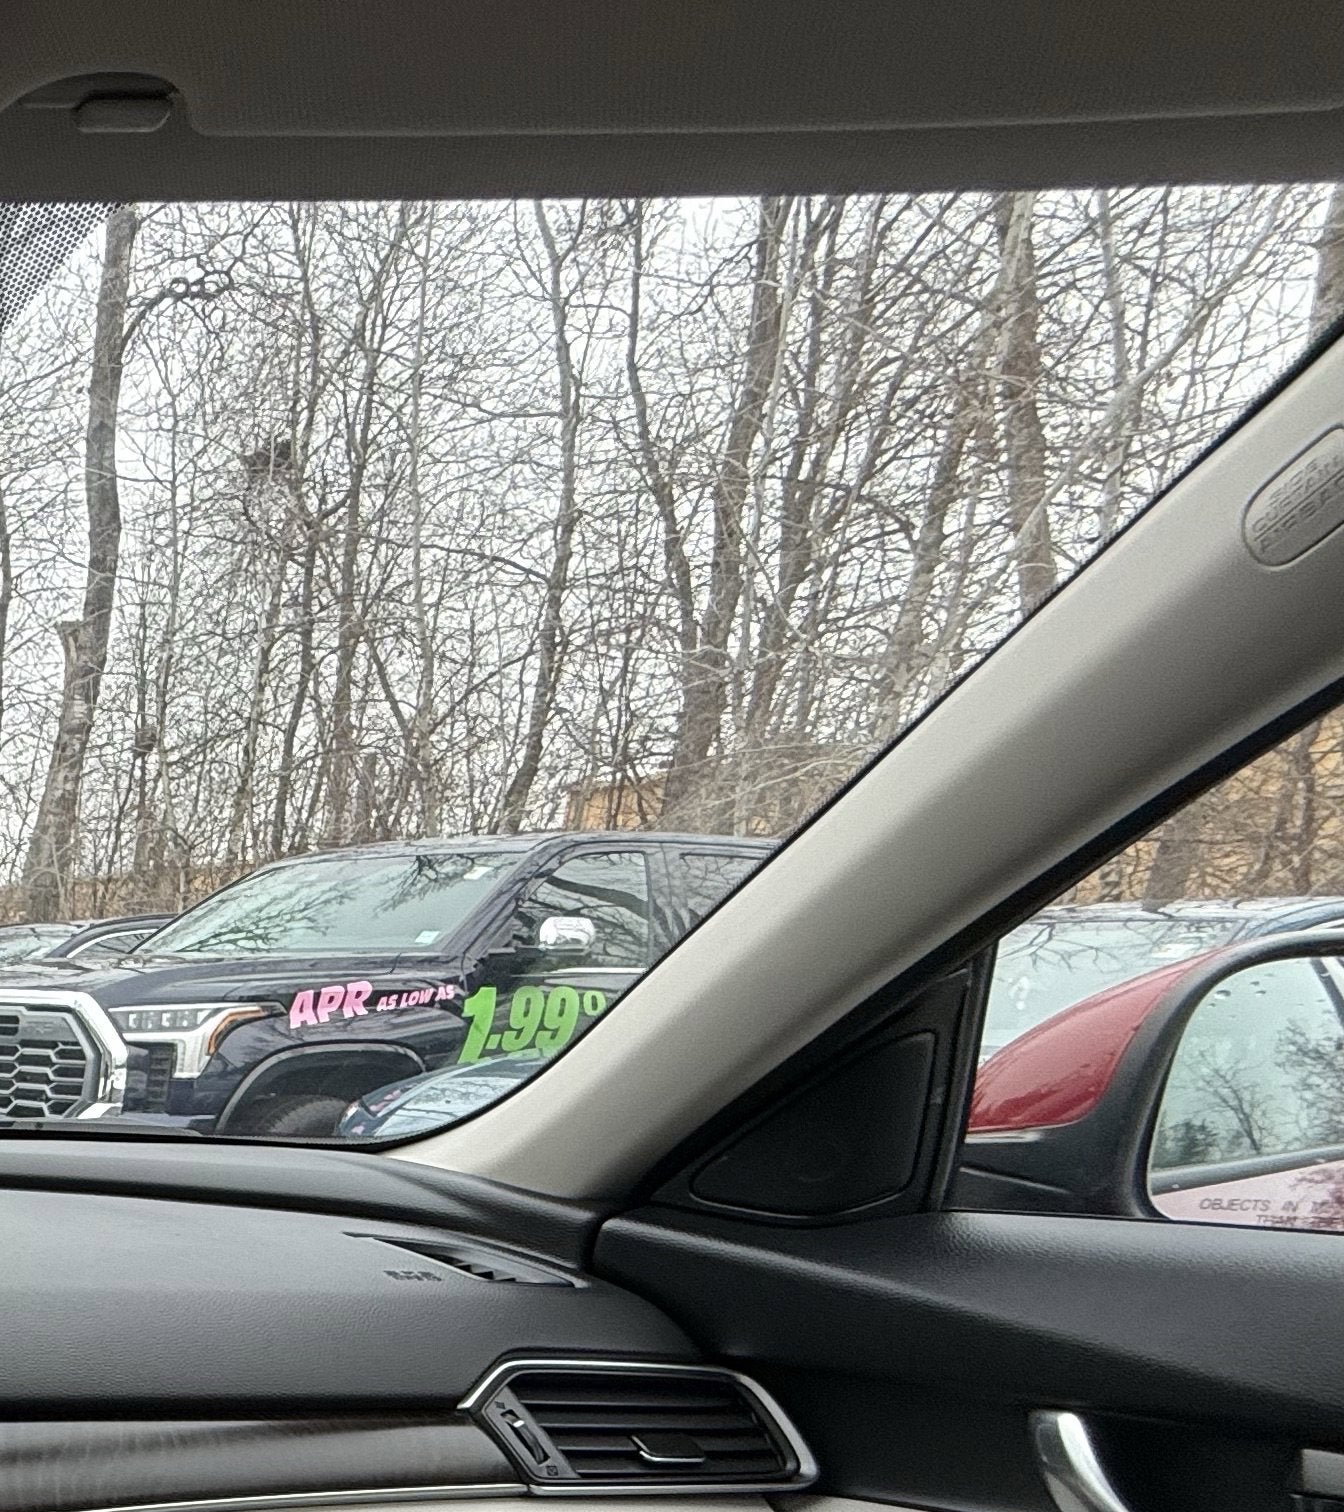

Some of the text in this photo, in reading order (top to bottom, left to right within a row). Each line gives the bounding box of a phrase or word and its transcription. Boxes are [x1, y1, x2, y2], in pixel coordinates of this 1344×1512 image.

[289, 980, 455, 1030] APR AS LOW AS
[1198, 1198, 1271, 1212] OBJECTS
